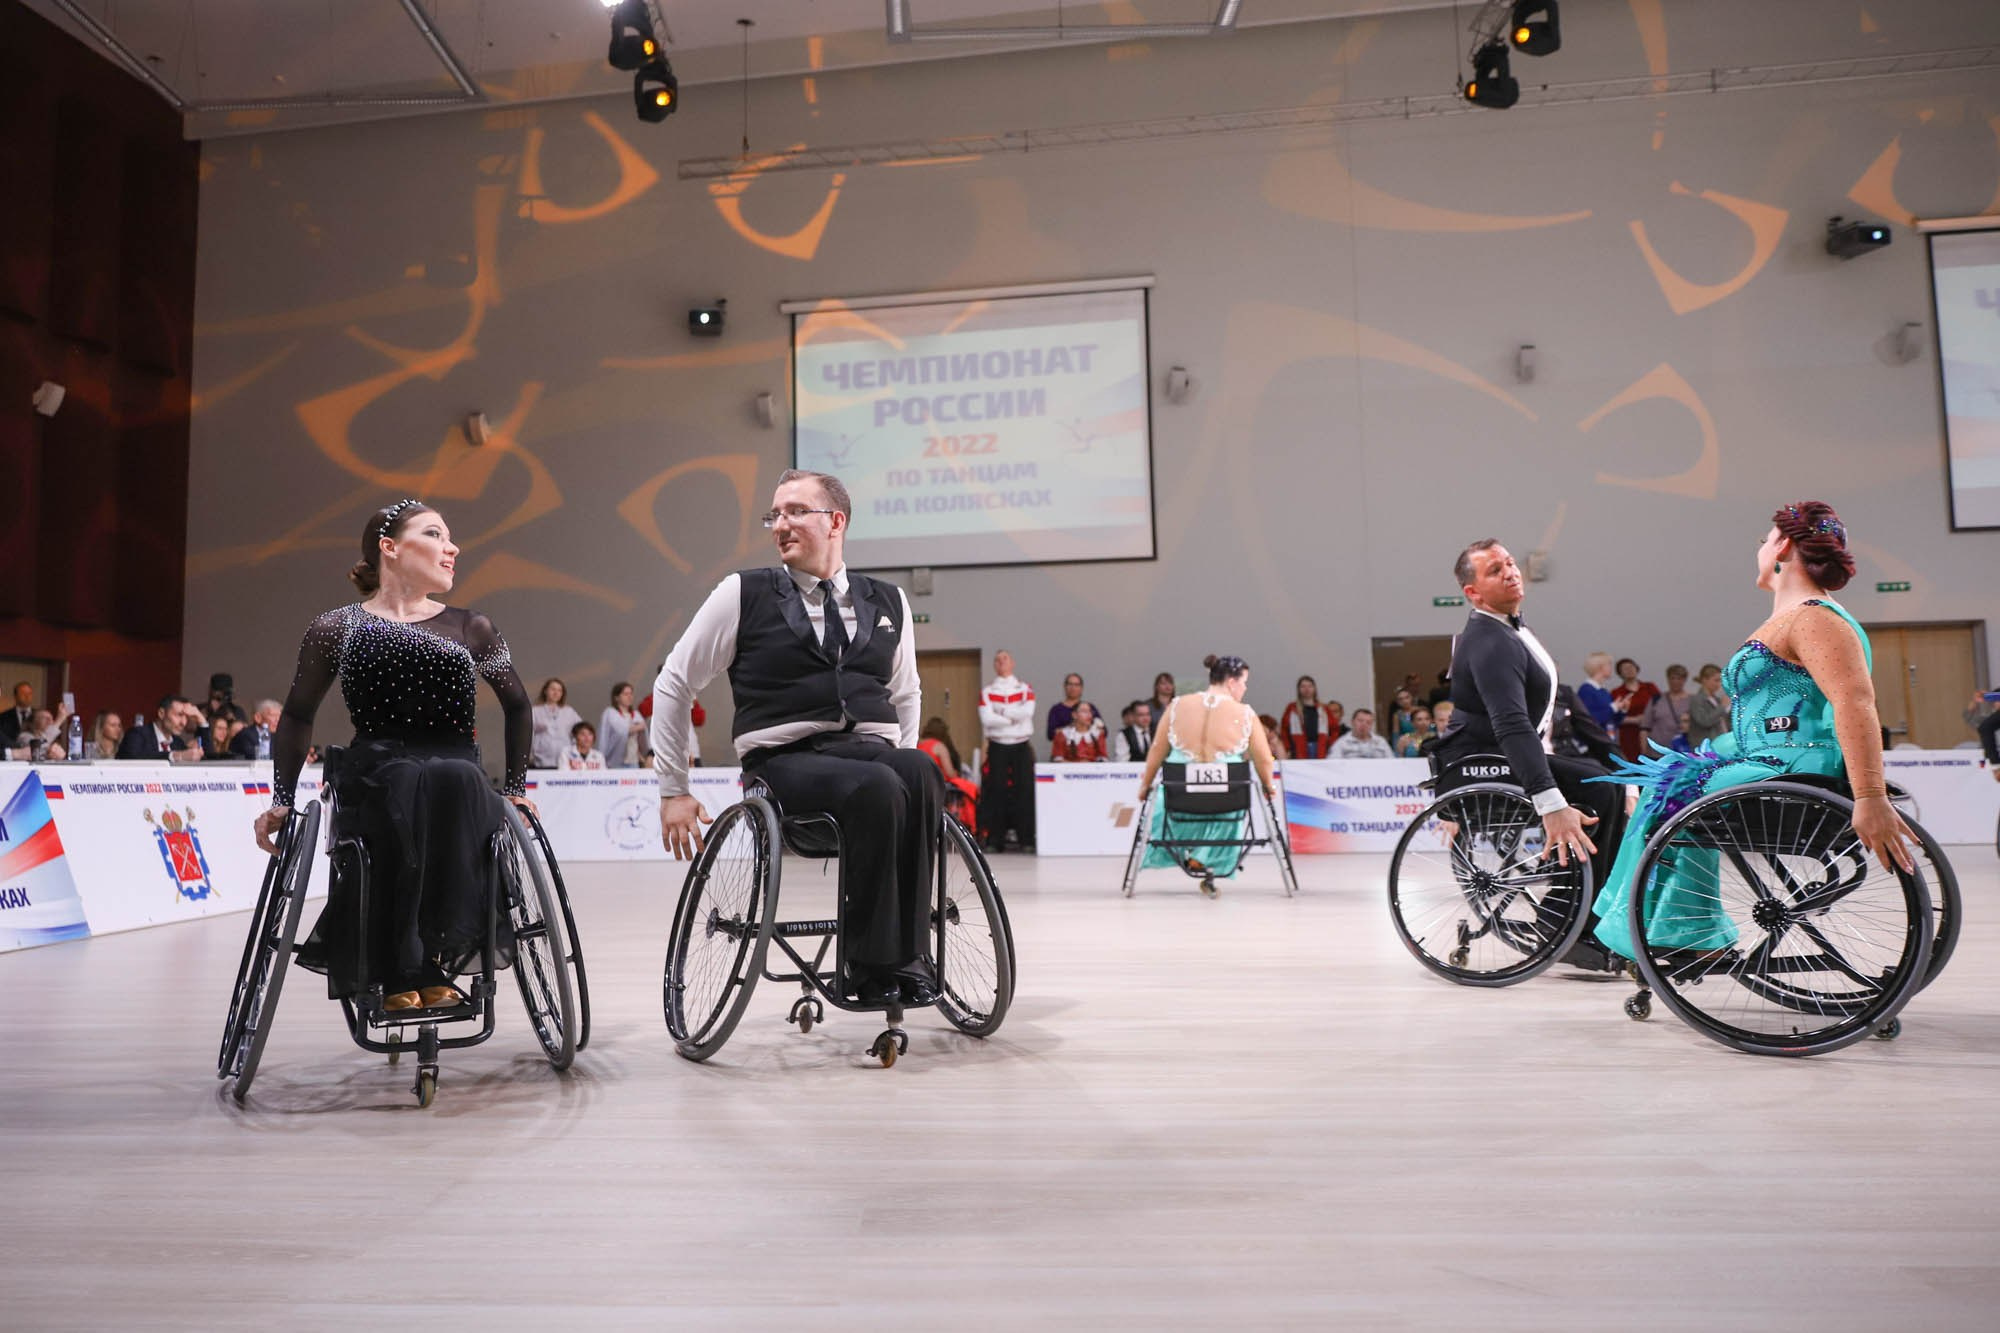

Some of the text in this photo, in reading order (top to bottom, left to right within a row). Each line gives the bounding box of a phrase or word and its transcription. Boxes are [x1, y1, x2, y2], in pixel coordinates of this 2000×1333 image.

[821, 344, 1099, 391] ЧЕМПИОНАТ
[874, 387, 1047, 428] РОССИИ
[922, 431, 998, 459] 2022
[887, 462, 1038, 487] ПО ТАНЦАМ
[873, 488, 1053, 515] НА КОЛЯСКАХ
[1194, 769, 1223, 784] 183
[1462, 765, 1511, 776] LUKOR
[69, 783, 117, 794] ЧЕМПИОНАТ
[117, 784, 145, 794] РОССИИ
[145, 783, 162, 793] 2022
[162, 783, 172, 793] ПО
[172, 783, 198, 793] ТАНЦАМ
[1326, 784, 1423, 800] ЧЕМПИОНАТ
[1330, 822, 1349, 833] ПО
[1351, 820, 1407, 833] ТАНЦАМ
